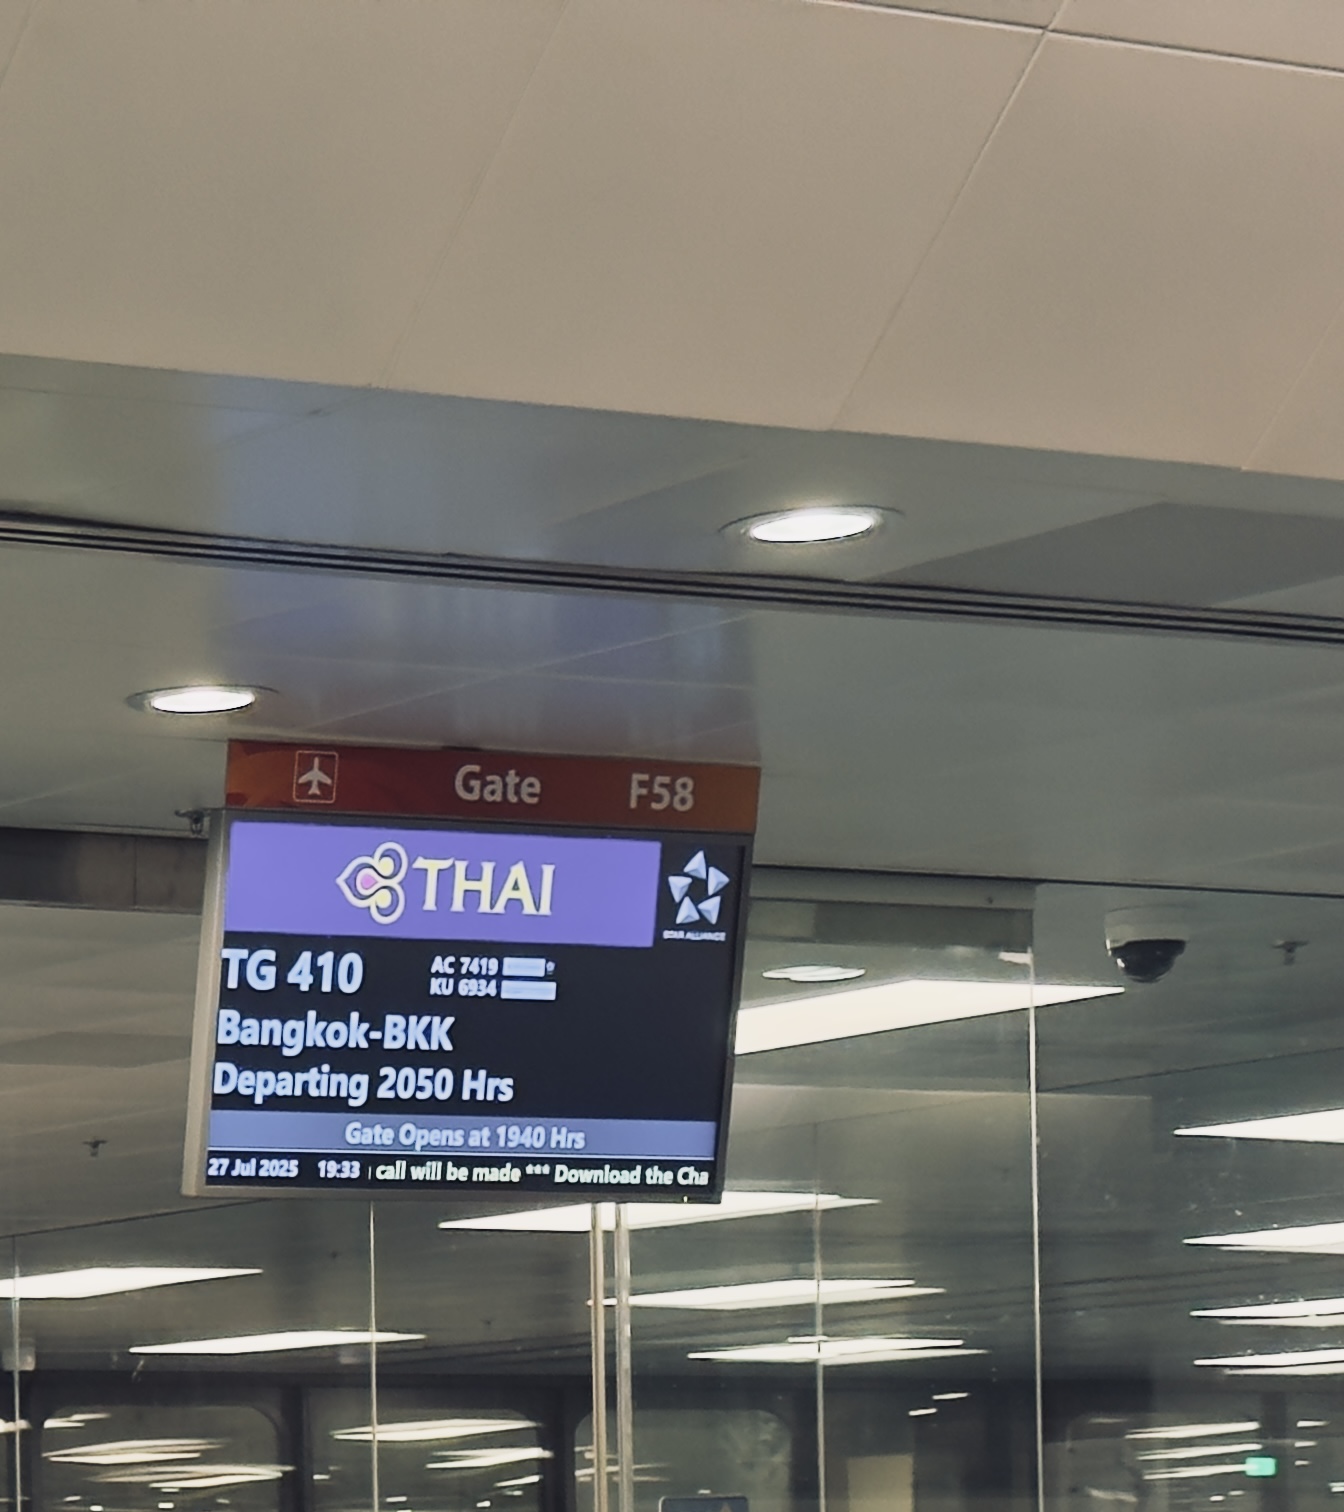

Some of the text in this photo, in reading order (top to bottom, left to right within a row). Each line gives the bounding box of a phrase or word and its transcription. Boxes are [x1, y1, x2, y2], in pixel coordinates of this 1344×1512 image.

[455, 764, 694, 812] Gate F58
[413, 857, 555, 916] THAI
[222, 948, 363, 994] TG 410
[431, 956, 499, 975] AC 7419
[430, 977, 497, 997] KU 6934
[217, 1010, 455, 1056] Bangkok-BKK
[213, 1063, 514, 1106] Departing 2050 Hrs
[345, 1122, 585, 1151] Gate Opens at 1940 Hrs
[208, 1158, 360, 1178] 27 Jul 2025 19:33
[375, 1160, 406, 1180] call
[411, 1161, 442, 1181] will
[446, 1162, 468, 1181] be
[472, 1163, 521, 1182] made
[555, 1165, 641, 1185] Download
[645, 1167, 673, 1185] the
[677, 1167, 709, 1186] Cha
